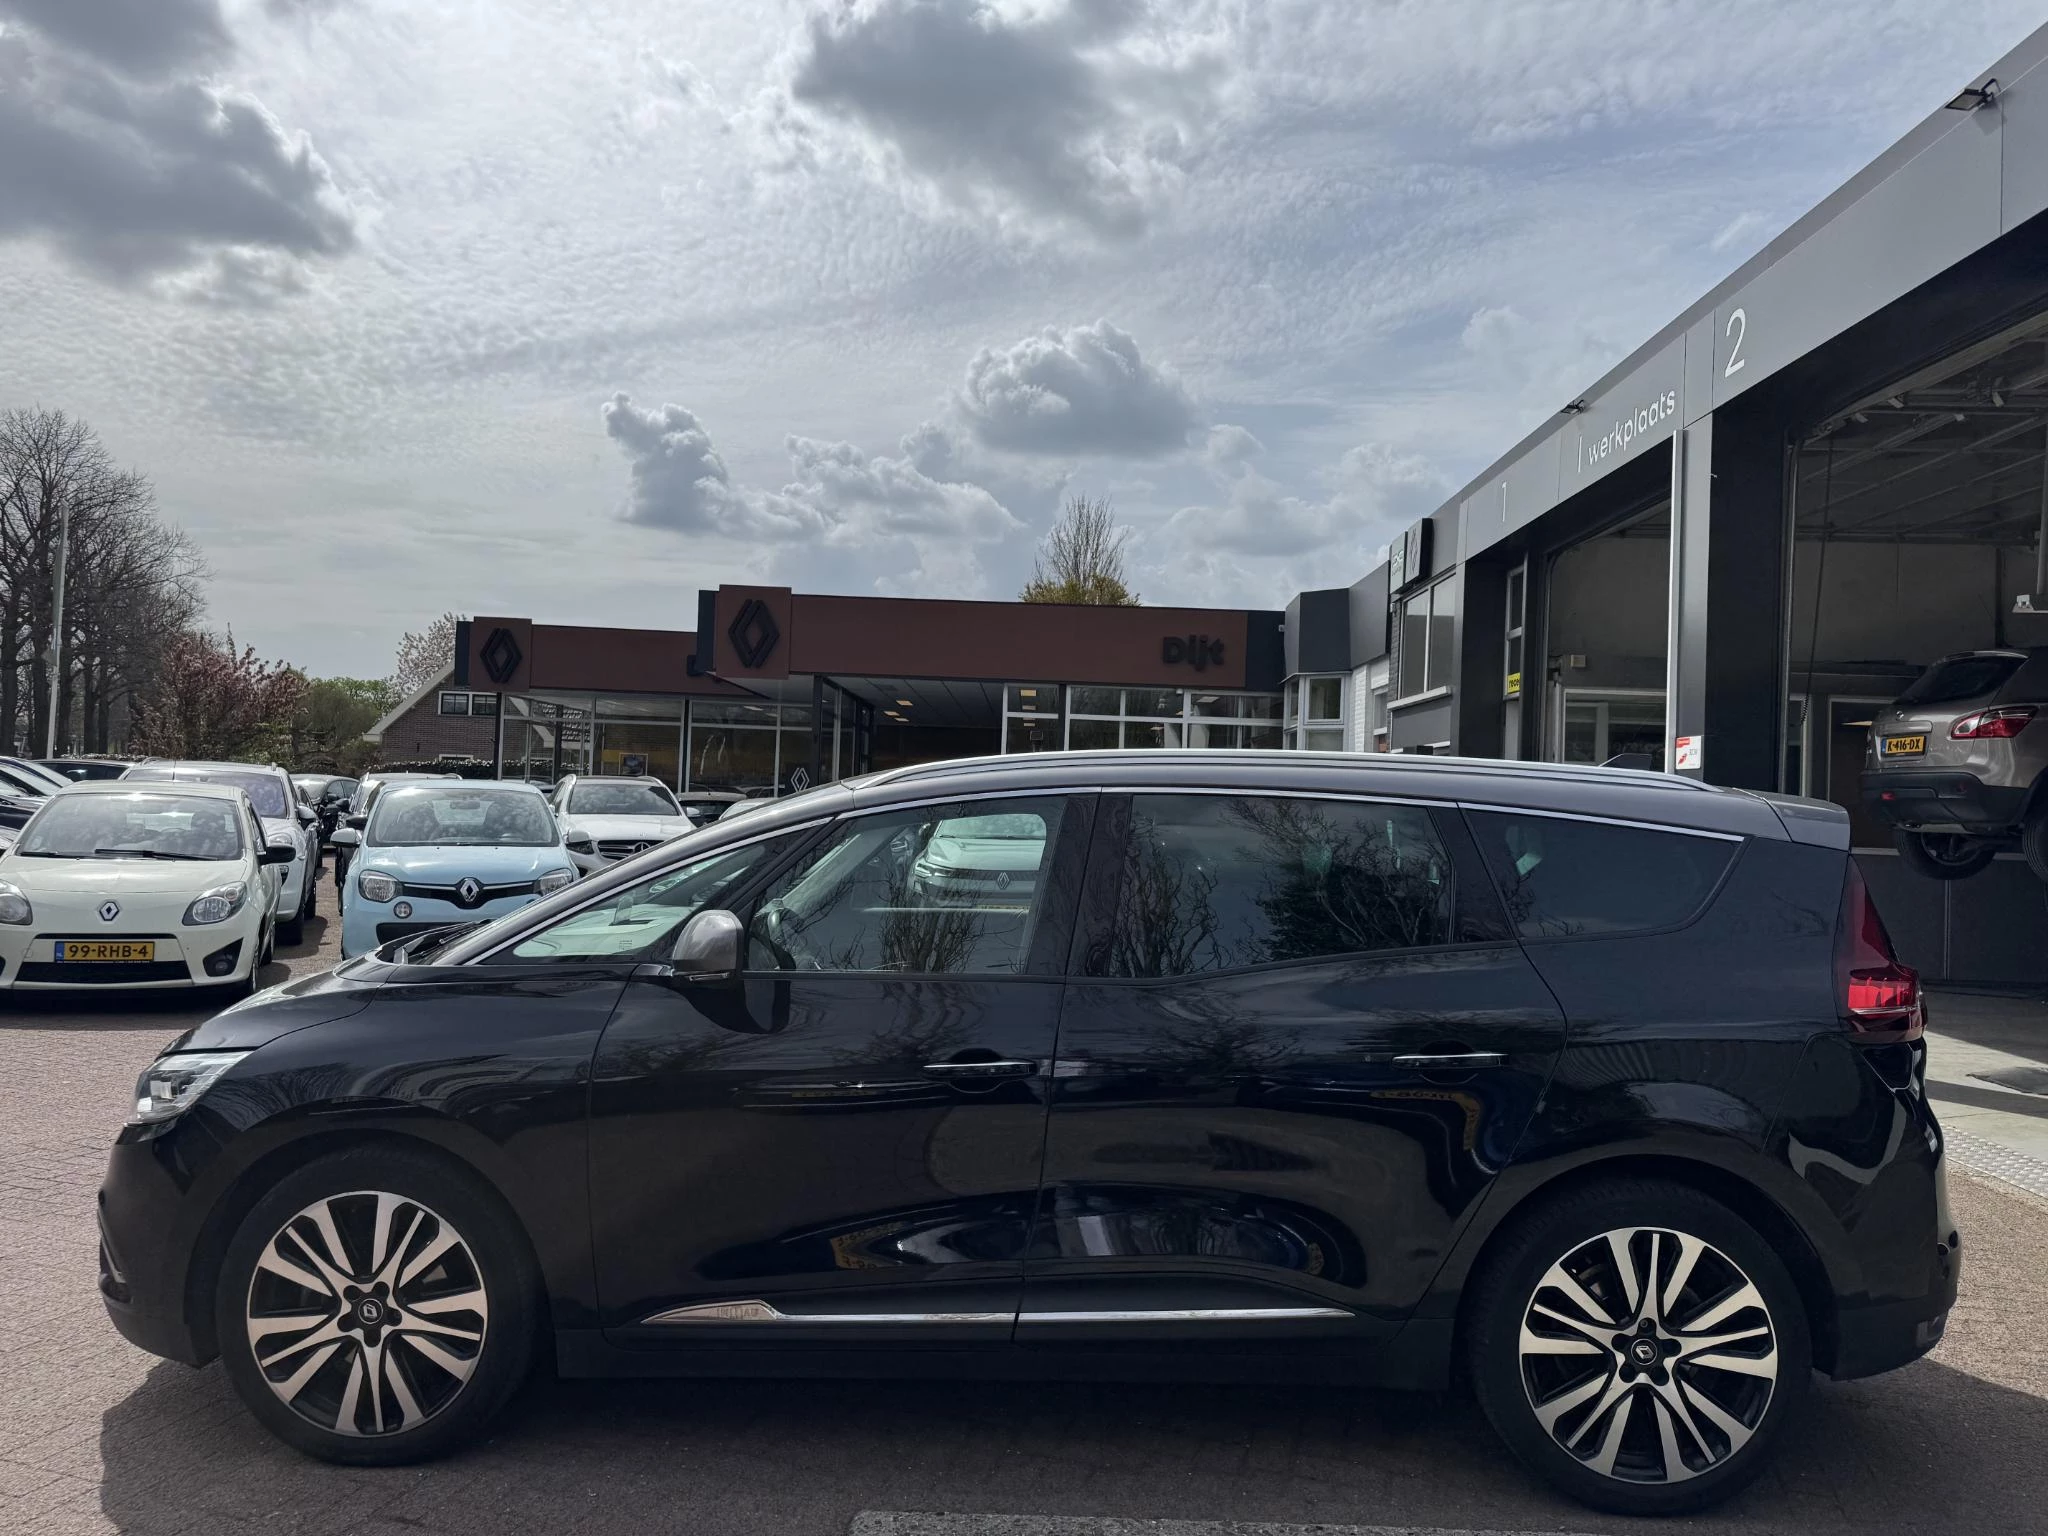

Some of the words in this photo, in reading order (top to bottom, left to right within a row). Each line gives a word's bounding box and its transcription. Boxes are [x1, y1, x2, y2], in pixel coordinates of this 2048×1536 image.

[1724, 308, 1746, 378] 2
[1588, 390, 1675, 465] werkplaats
[1501, 481, 1507, 522] 1
[1162, 634, 1224, 673] Dijt
[69, 945, 148, 958] 99-RHB-4
